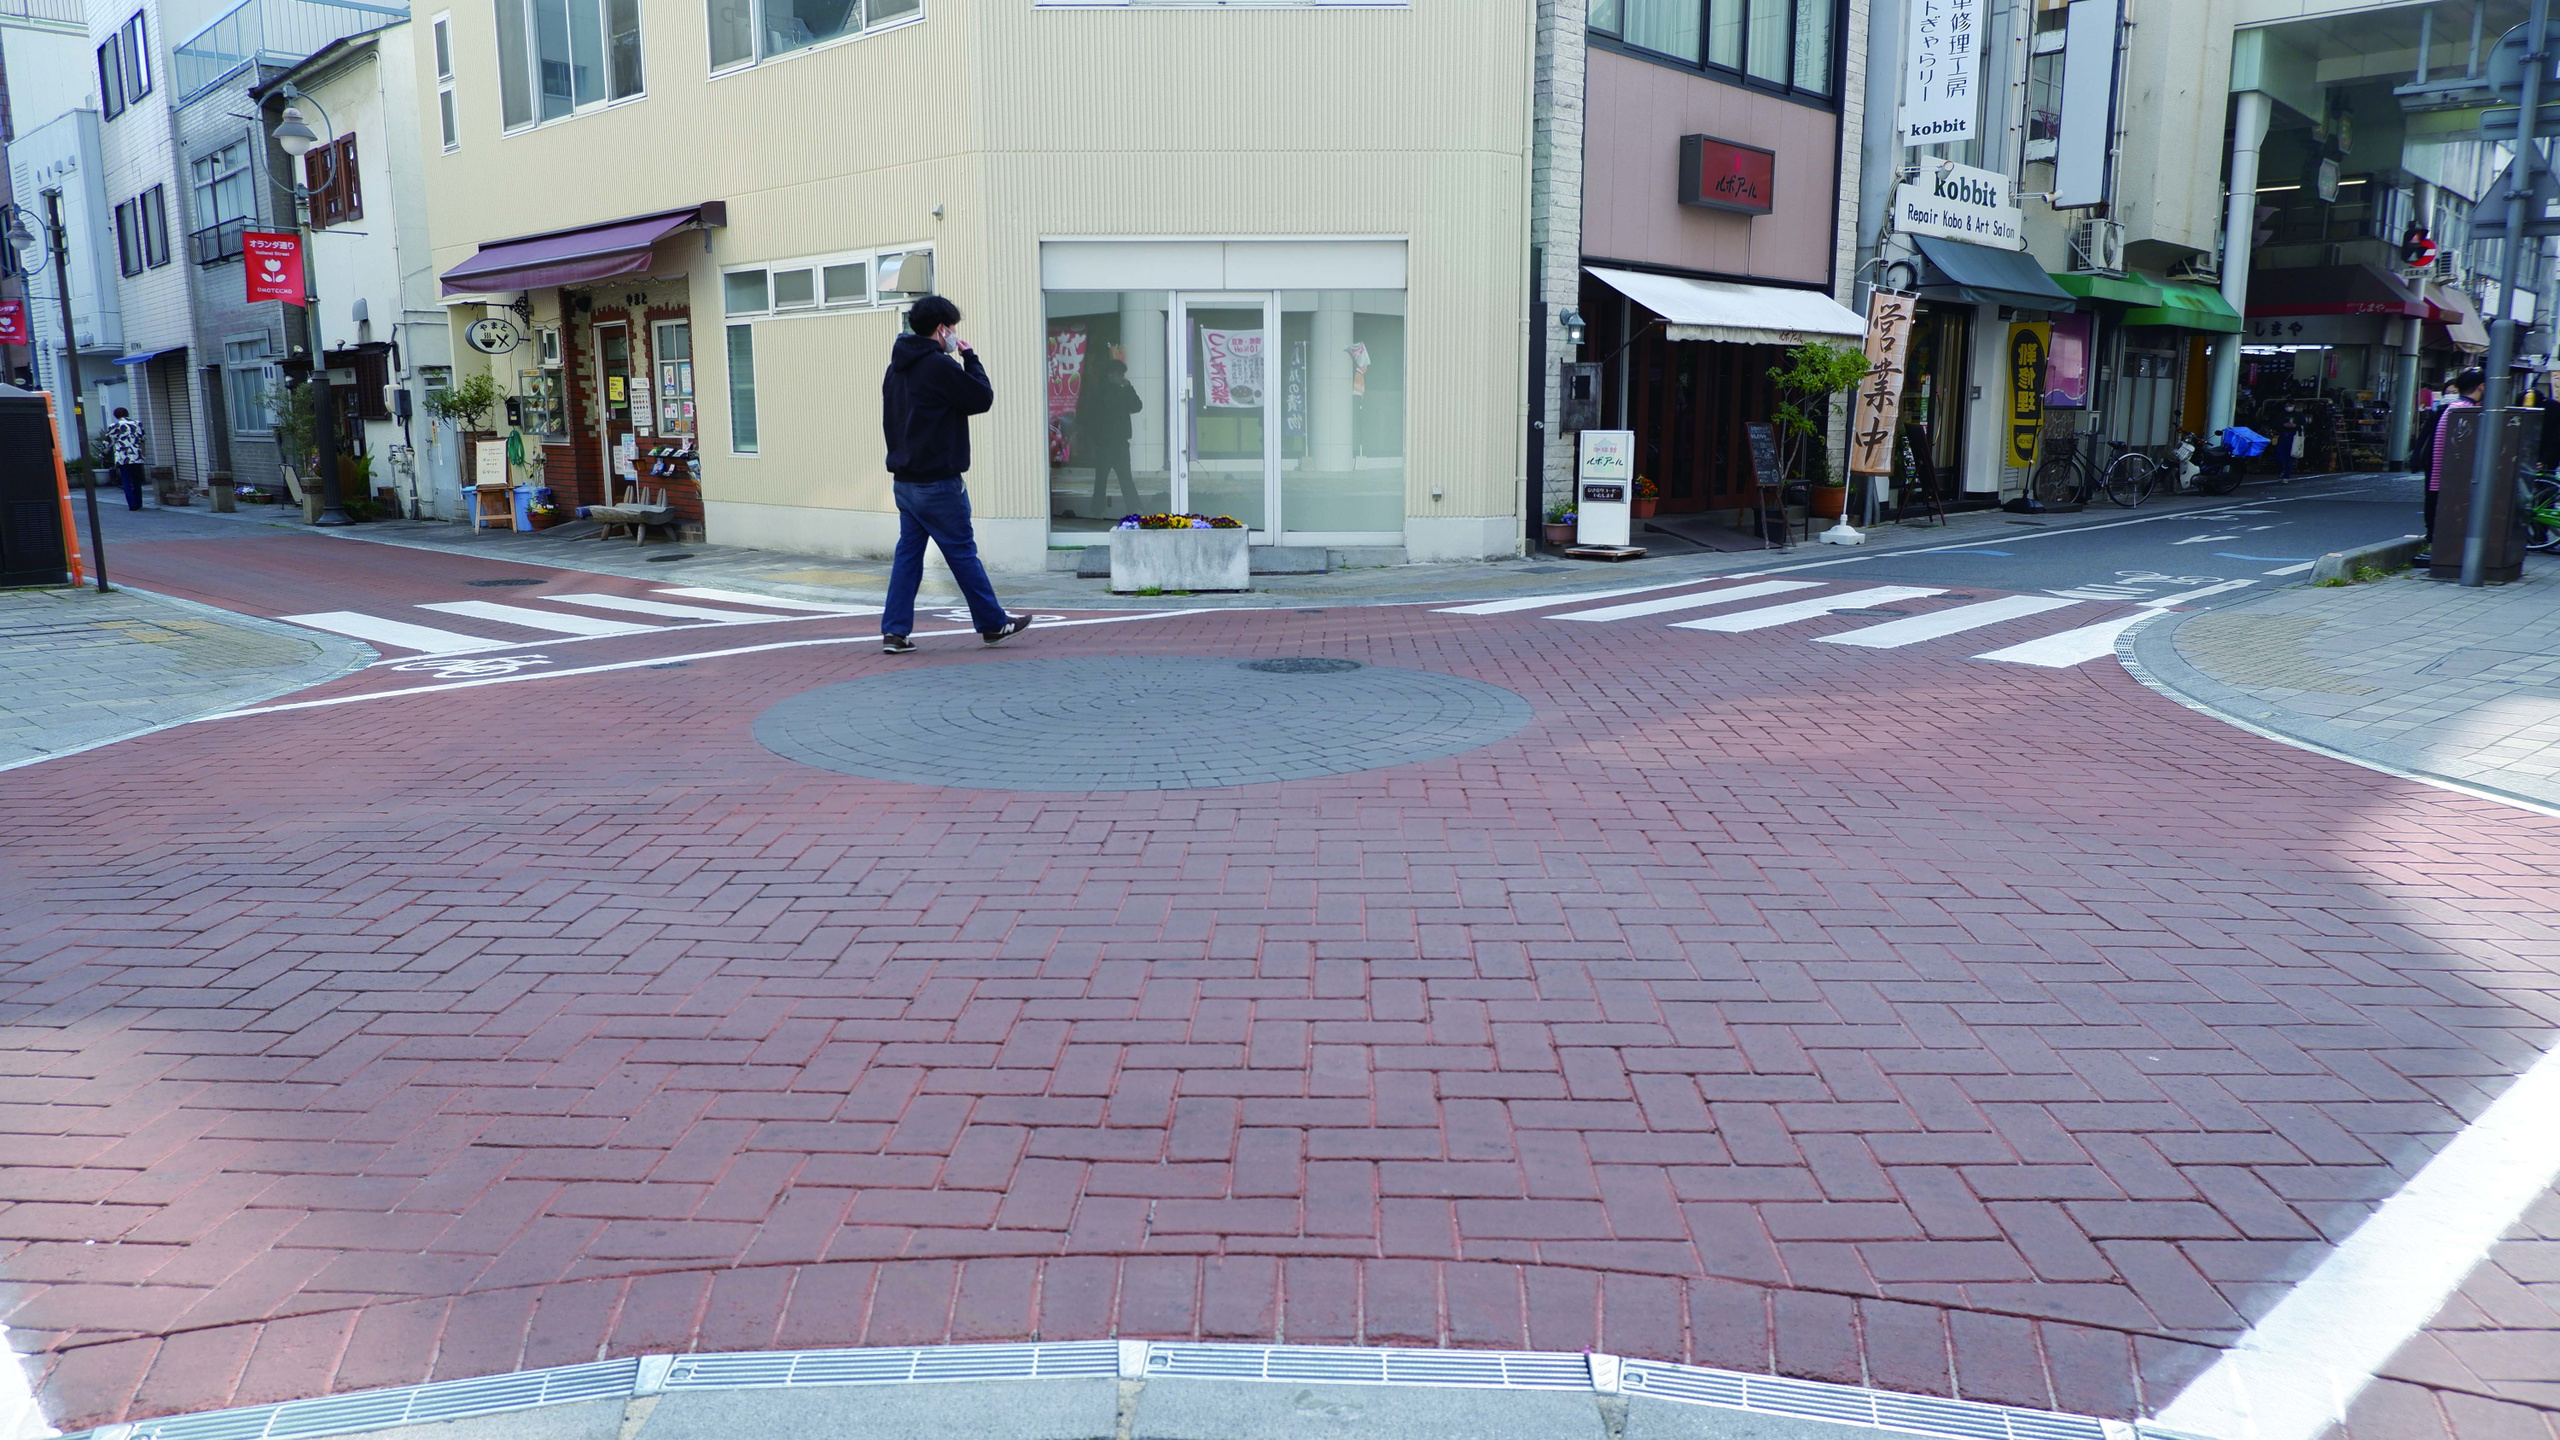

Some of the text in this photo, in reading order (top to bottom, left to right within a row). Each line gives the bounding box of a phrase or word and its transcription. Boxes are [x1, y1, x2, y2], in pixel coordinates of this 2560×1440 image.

[1911, 118, 1966, 137] kobbit
[1933, 171, 1997, 208] kobbit
[1907, 203, 2015, 239] Repair Kobo & Art Salon
[249, 240, 295, 250] オランダ通り
[625, 292, 648, 307] やまと
[2358, 302, 2386, 313] しまや
[479, 321, 507, 333] やまと
[2255, 320, 2303, 337] しまや
[1856, 303, 1907, 466] 営業中
